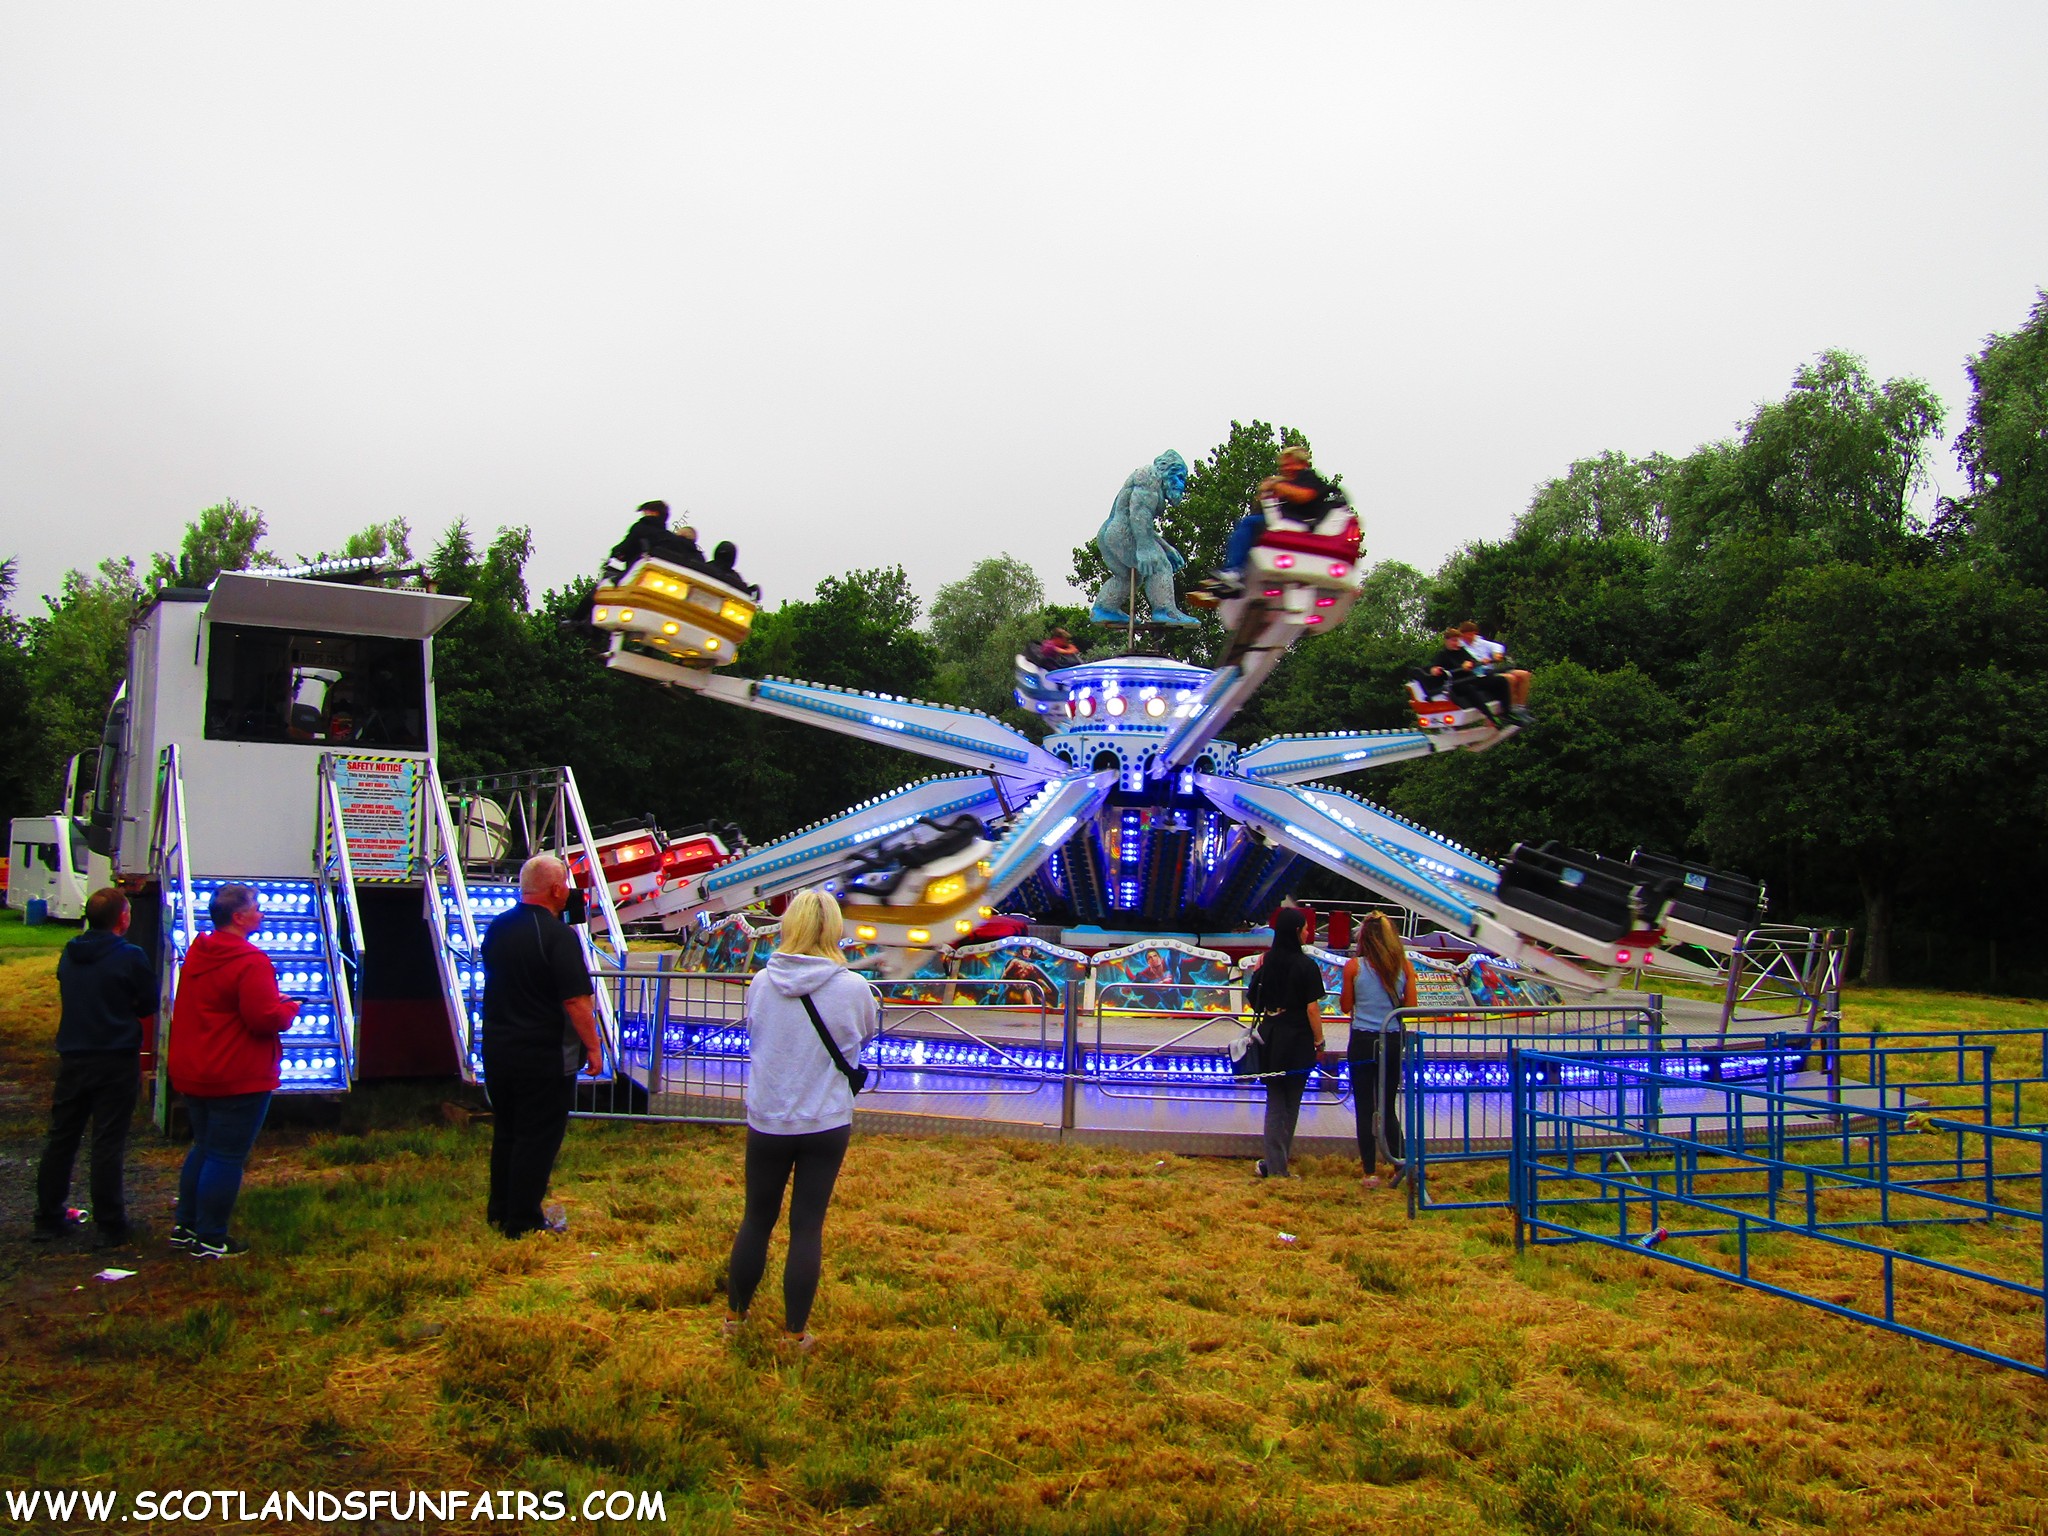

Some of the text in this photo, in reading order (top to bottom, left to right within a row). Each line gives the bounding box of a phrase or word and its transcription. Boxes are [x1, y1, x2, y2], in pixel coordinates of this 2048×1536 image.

[347, 762, 402, 772] SAFETY NOTICE
[1417, 973, 1452, 982] EVENTS
